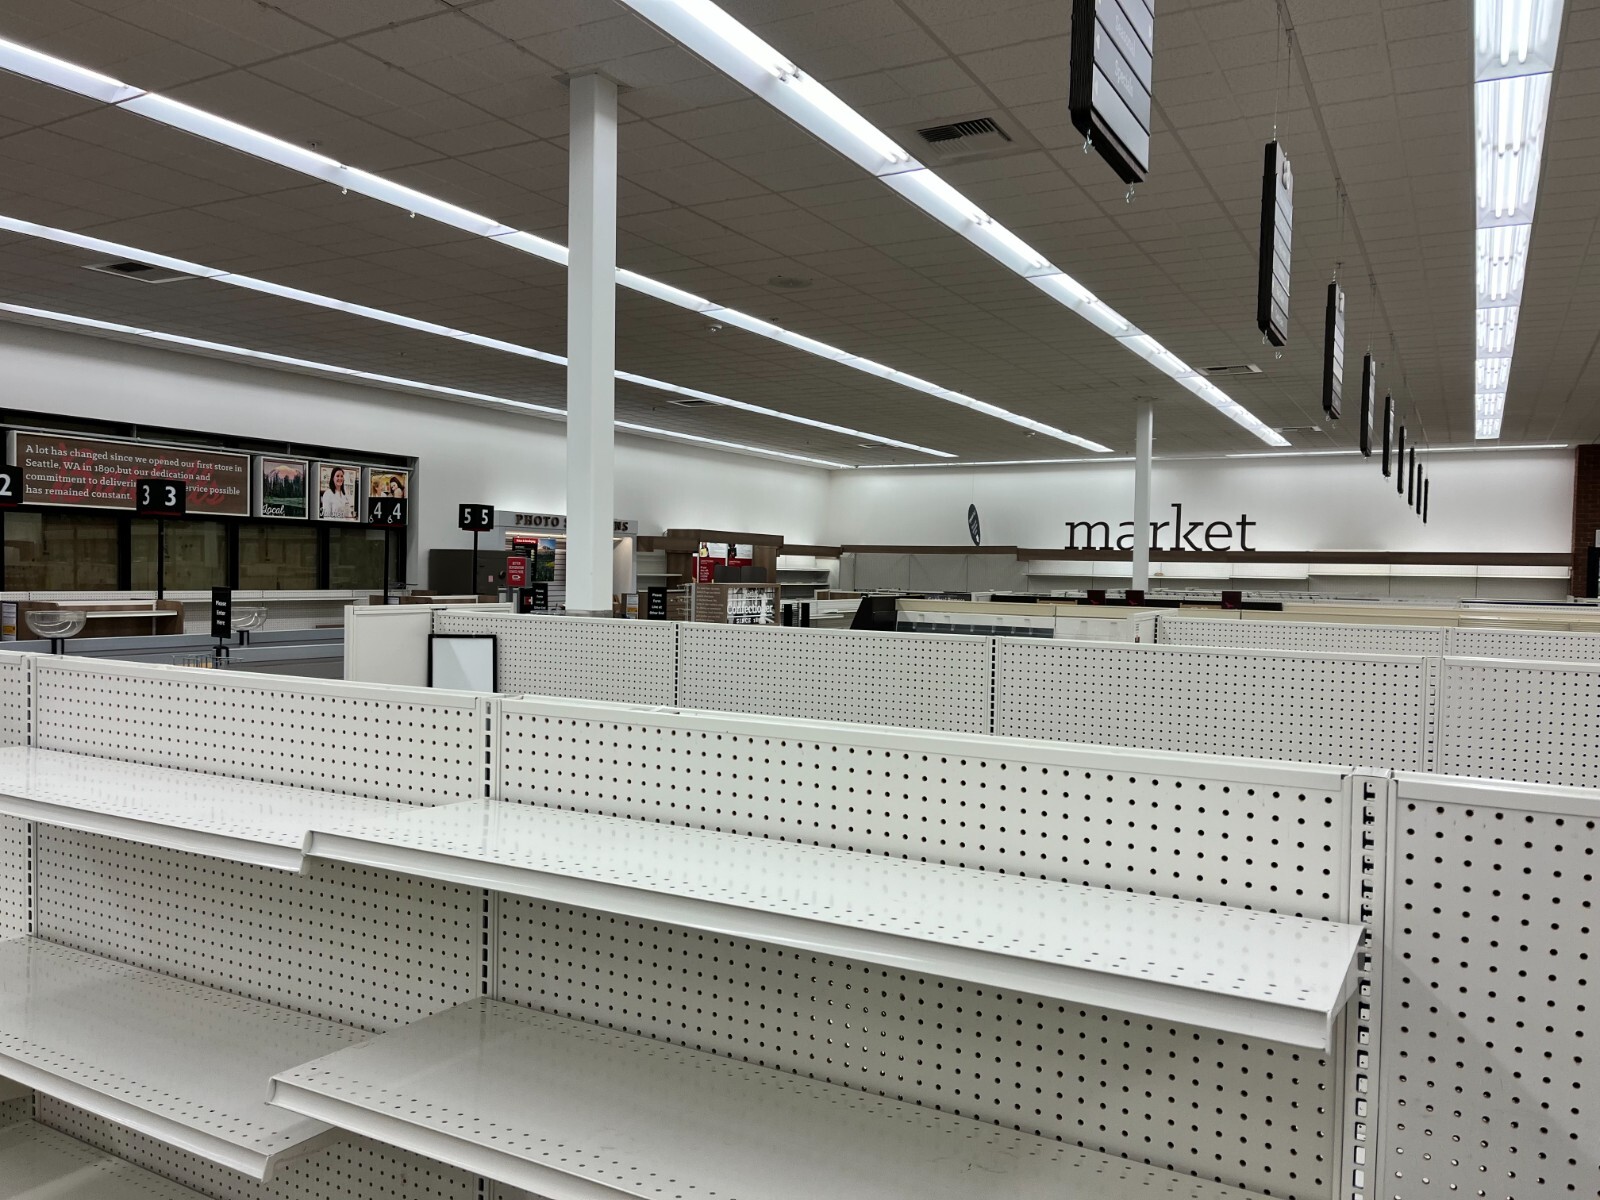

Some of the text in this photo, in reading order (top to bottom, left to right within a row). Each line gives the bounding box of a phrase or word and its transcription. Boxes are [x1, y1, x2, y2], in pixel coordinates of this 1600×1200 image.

[26, 444, 34, 454] A
[36, 445, 48, 454] lot
[51, 446, 67, 456] has
[70, 448, 108, 460] changed
[110, 452, 132, 462] since
[149, 458, 179, 468] opened
[196, 460, 212, 470] first
[214, 464, 233, 472] store
[26, 458, 61, 469] Seattle,
[63, 462, 81, 471] WA
[82, 463, 92, 471] in
[150, 468, 194, 480] dedication
[196, 473, 210, 481] and
[0, 474, 12, 496] 2
[26, 473, 86, 484] commitment
[210, 486, 240, 495] possible
[26, 484, 132, 500] has remained constant.
[142, 485, 150, 505] 3
[165, 486, 176, 506] 3
[369, 514, 374, 523] 6
[374, 502, 382, 519] 4
[393, 503, 402, 519] 4
[464, 508, 471, 524] 5
[481, 509, 488, 524] 5
[387, 515, 393, 524] 6
[515, 514, 559, 528] PHOTO
[1064, 503, 1256, 551] market
